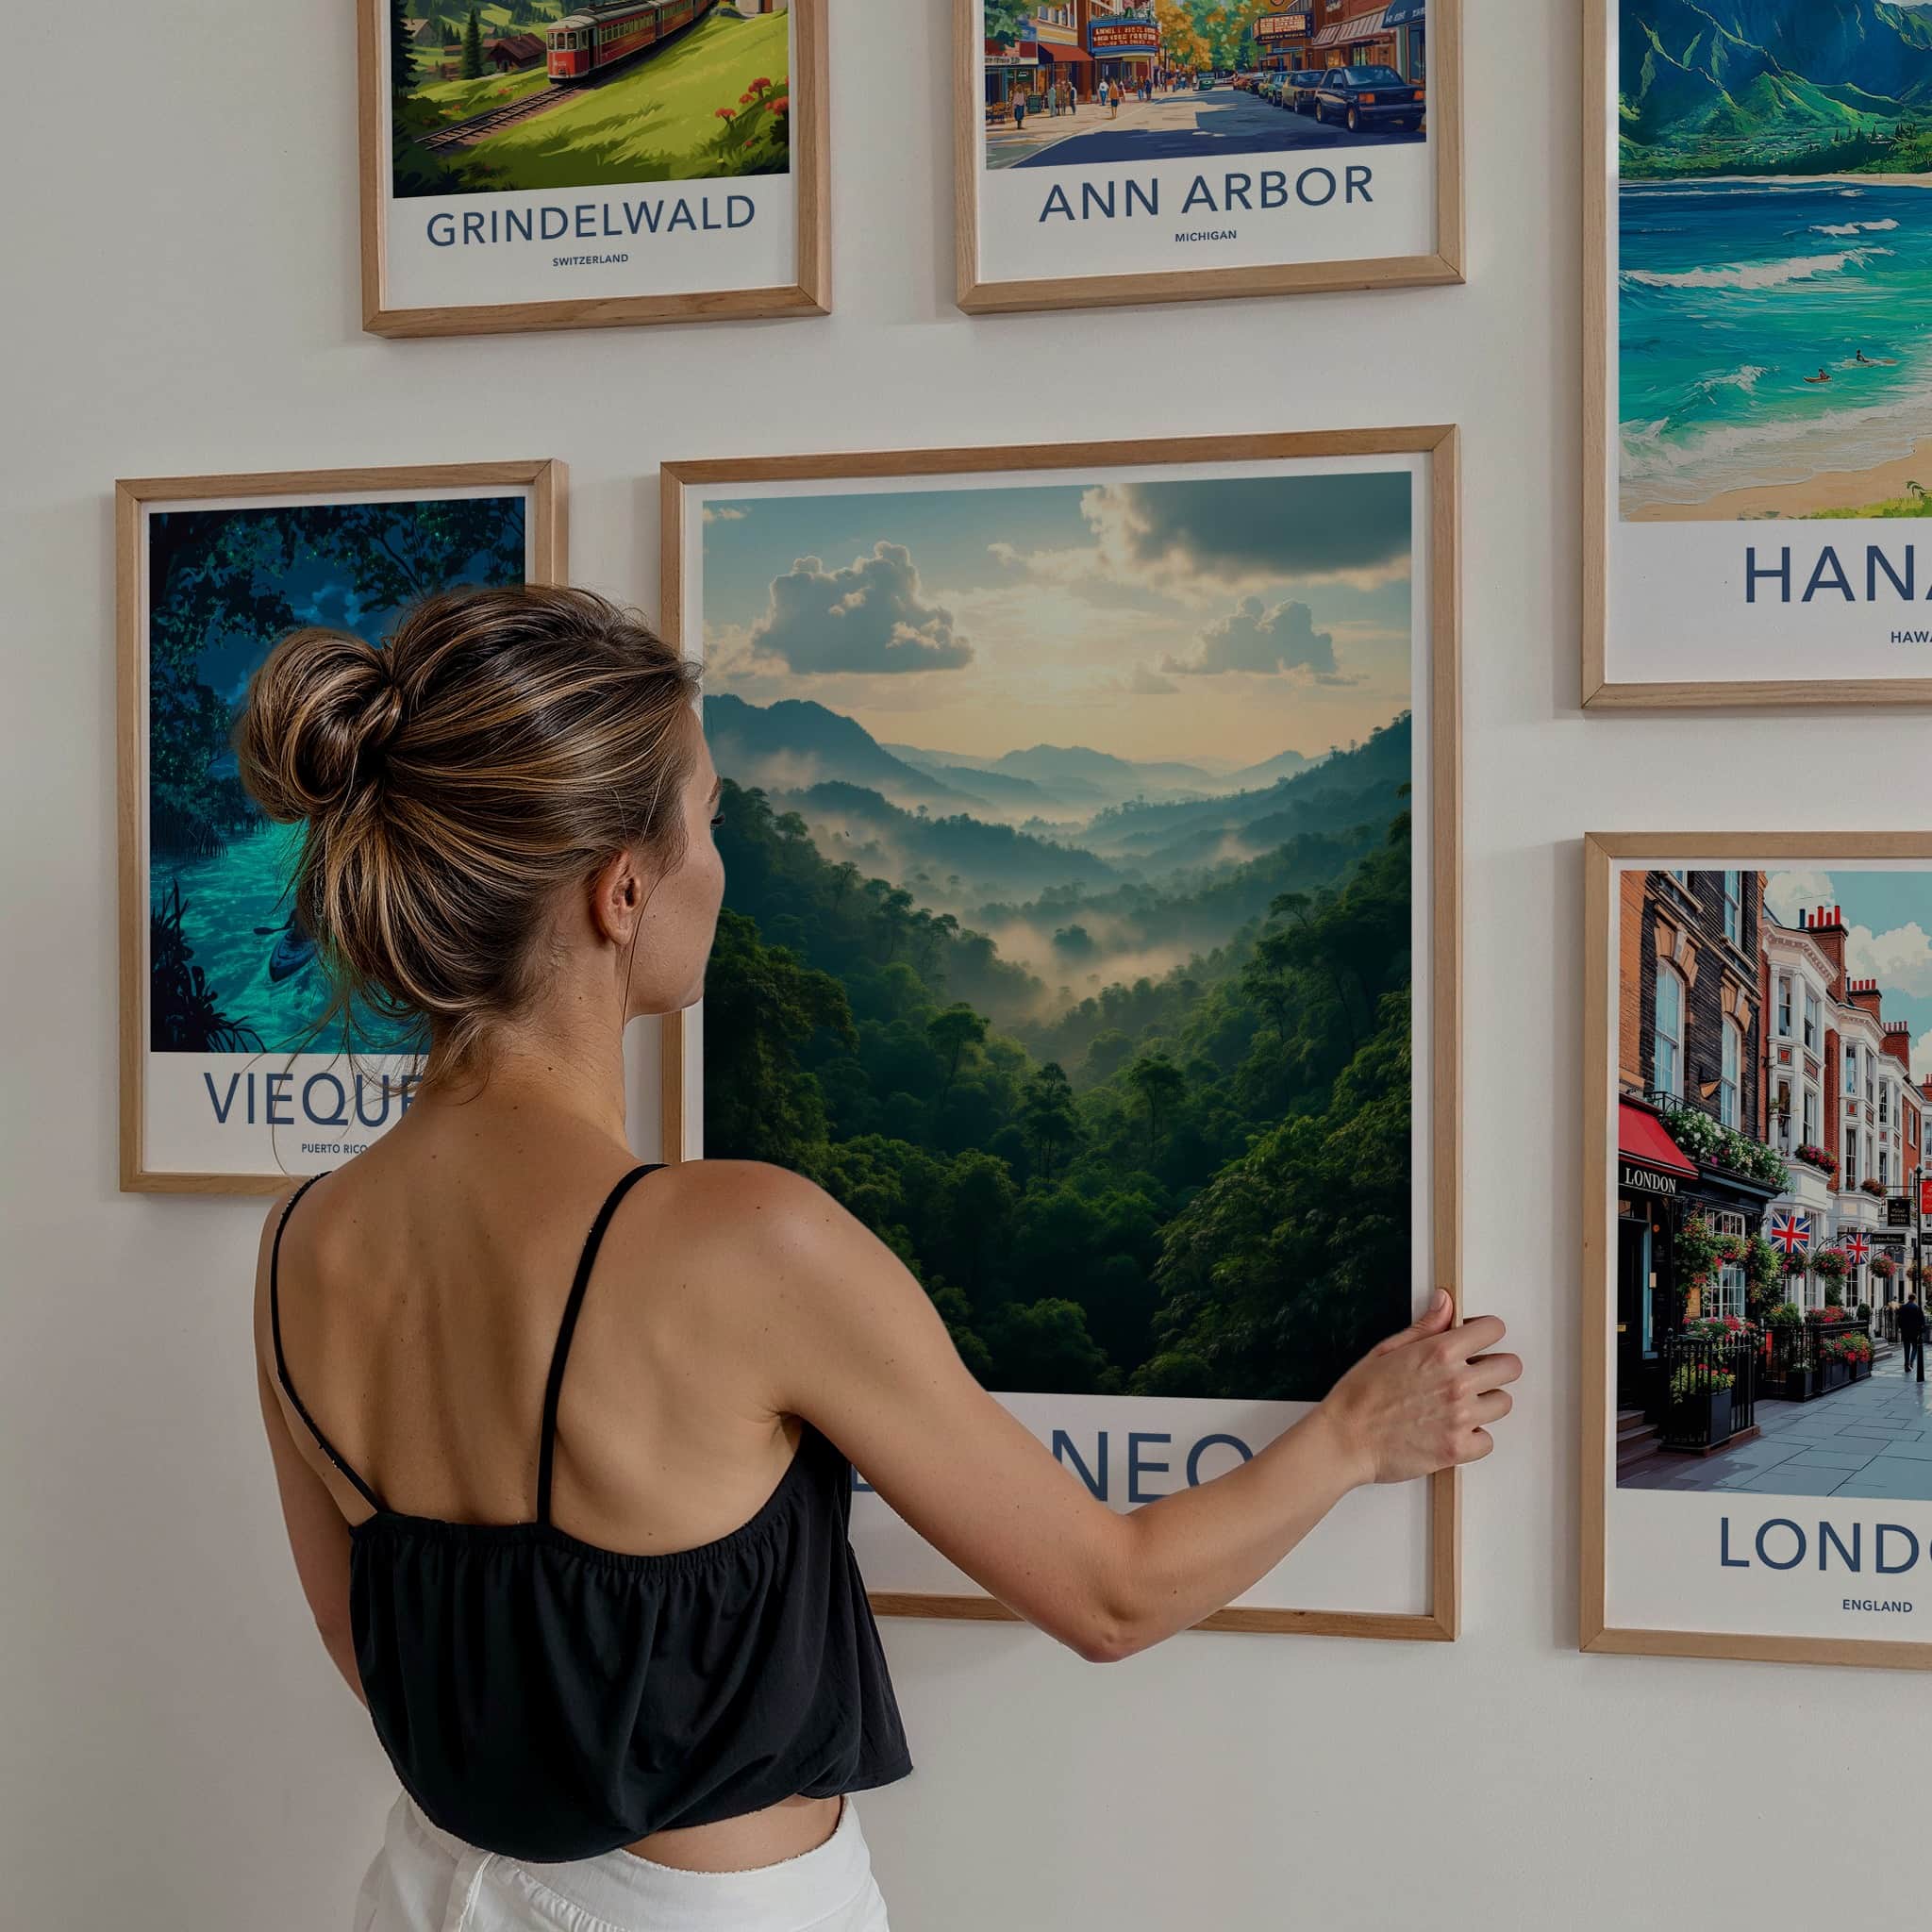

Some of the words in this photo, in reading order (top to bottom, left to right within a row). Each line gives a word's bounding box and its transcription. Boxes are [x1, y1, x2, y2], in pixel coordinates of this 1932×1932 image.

[1040, 177, 1159, 223] ANN
[1181, 165, 1374, 213] ARBOR
[426, 194, 756, 247] GRINDELWALD
[1174, 229, 1237, 242] MICHIGAN
[552, 253, 629, 268] SWITZERLAND
[1745, 544, 1932, 604] HAN
[1890, 631, 1932, 643] HAW
[301, 1143, 341, 1154] PUERTO
[1624, 1167, 1676, 1194] LONDON
[1720, 1517, 1932, 1574] LOND
[1842, 1599, 1913, 1613] ENGLAND
